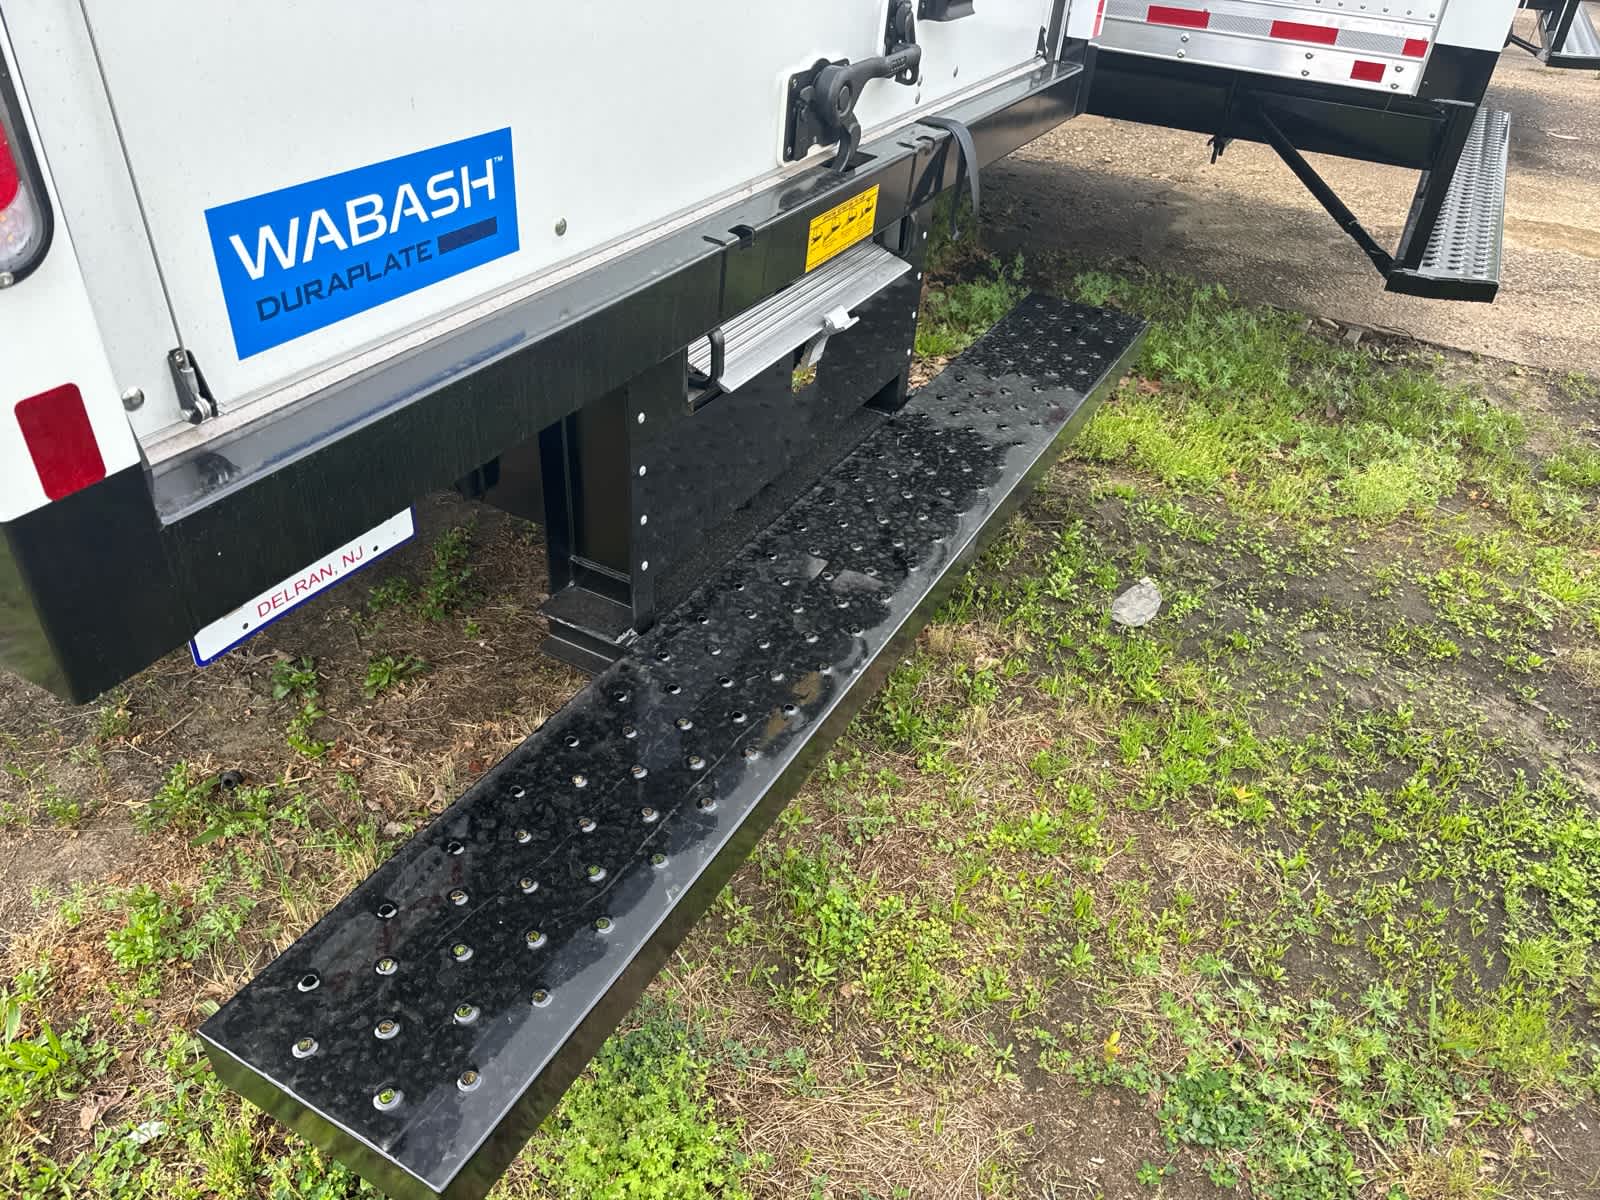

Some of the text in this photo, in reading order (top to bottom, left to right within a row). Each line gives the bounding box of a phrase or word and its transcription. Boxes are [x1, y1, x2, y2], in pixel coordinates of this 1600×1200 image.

[228, 158, 496, 281] WABASH
[256, 240, 433, 322] DURAPLATE
[257, 546, 364, 618] DELRAN, NJ
